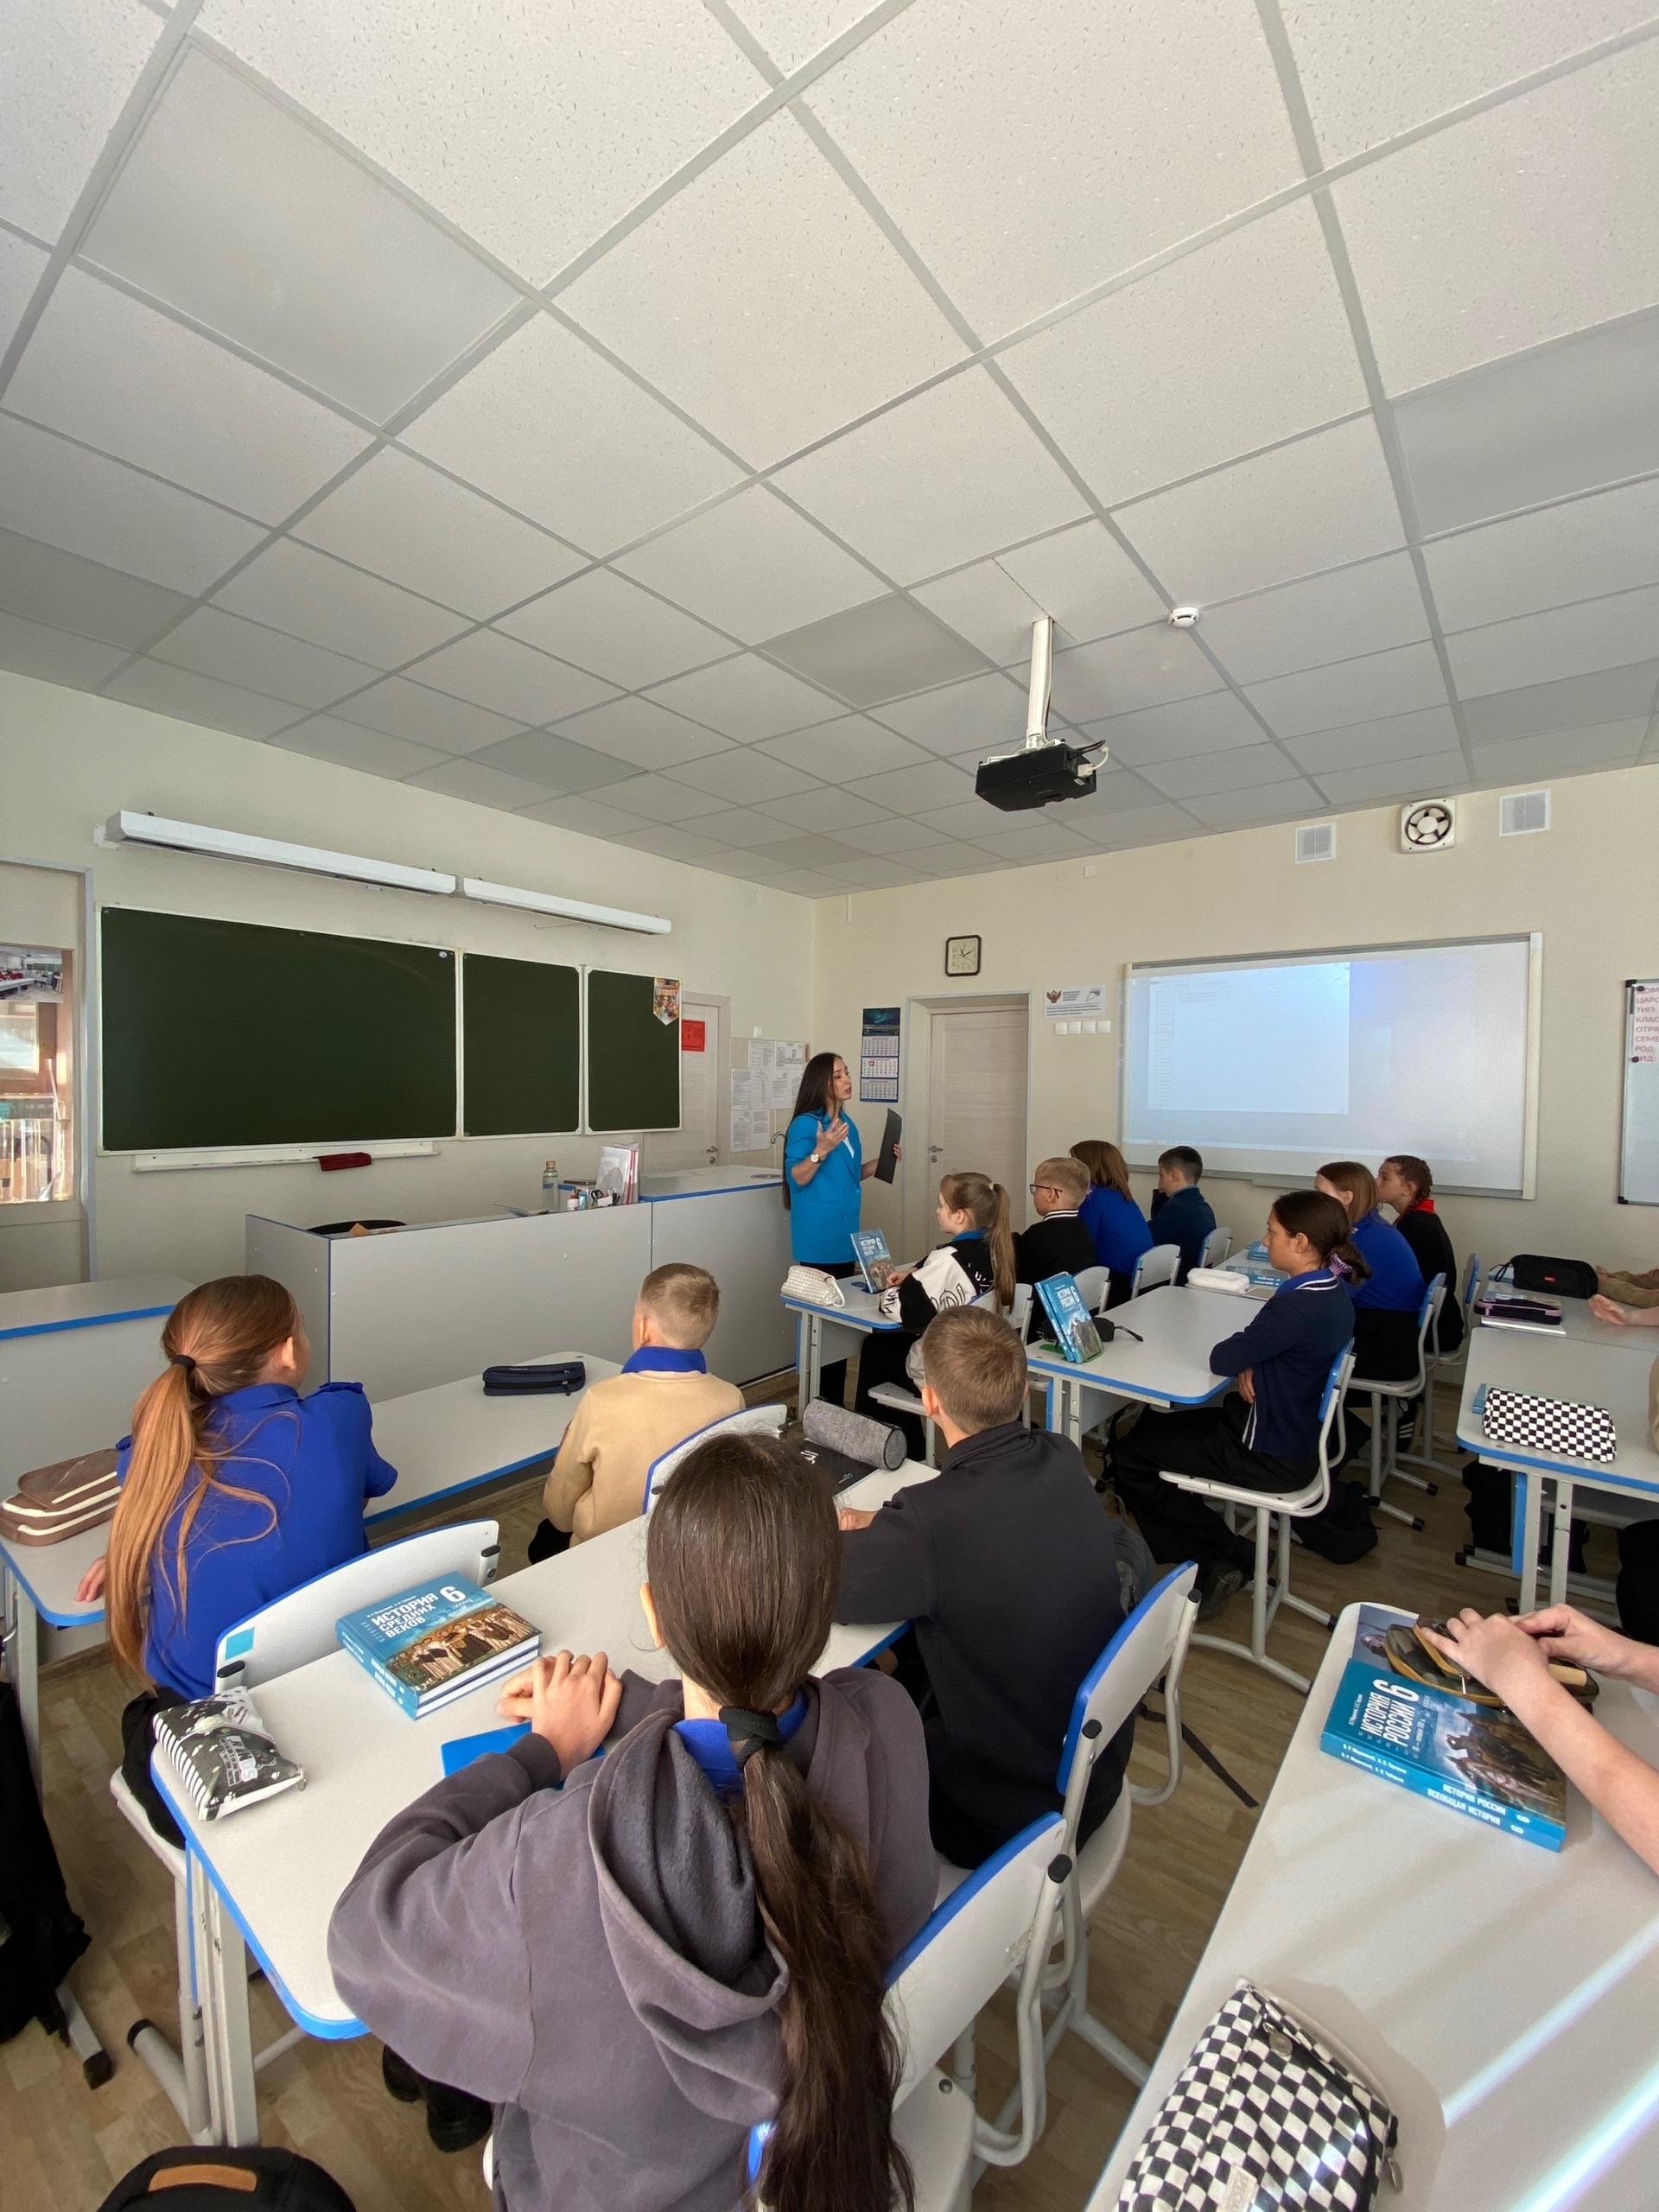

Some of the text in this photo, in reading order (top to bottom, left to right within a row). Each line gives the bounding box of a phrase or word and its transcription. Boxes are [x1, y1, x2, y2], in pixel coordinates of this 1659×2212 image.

[1070, 1286, 1080, 1303] 6
[371, 1592, 439, 1626] ИСТОРИЯ
[439, 1586, 467, 1603] 6
[378, 1604, 436, 1631] СРЕДНИХ
[385, 1616, 427, 1638] ВЕКОВ
[1372, 1679, 1420, 1702] 6
[1360, 1692, 1391, 1737] ИСТОРИЯ
[1382, 1699, 1415, 1747] РОССИИ
[1427, 1788, 1524, 1834] ВСЕОБЩАЯ ИСТОРИЯ 6
[1442, 1783, 1530, 1824] ИСТОРИЯ РОССИИ 6
